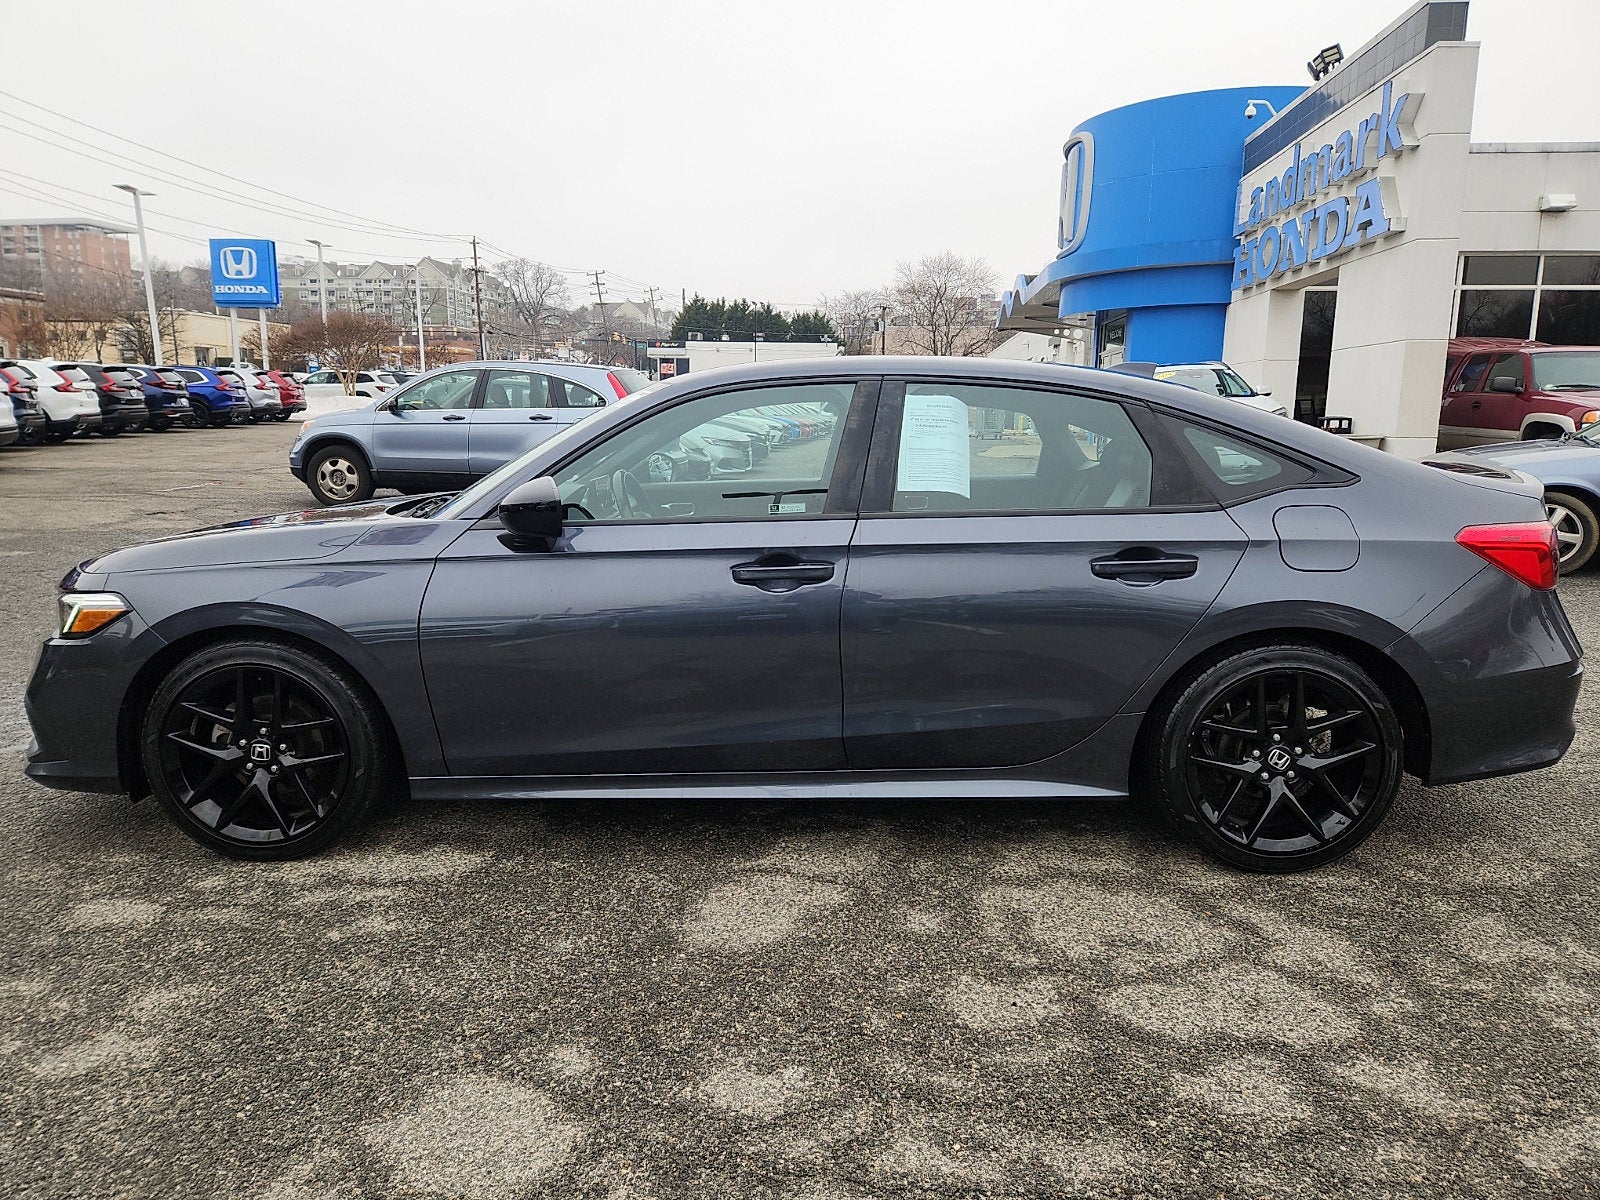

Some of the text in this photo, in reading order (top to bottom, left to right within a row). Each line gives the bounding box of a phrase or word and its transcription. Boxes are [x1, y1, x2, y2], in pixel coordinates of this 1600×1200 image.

[1232, 80, 1409, 239] Landmark
[214, 285, 269, 294] HONDA
[1231, 177, 1391, 291] HONDA
